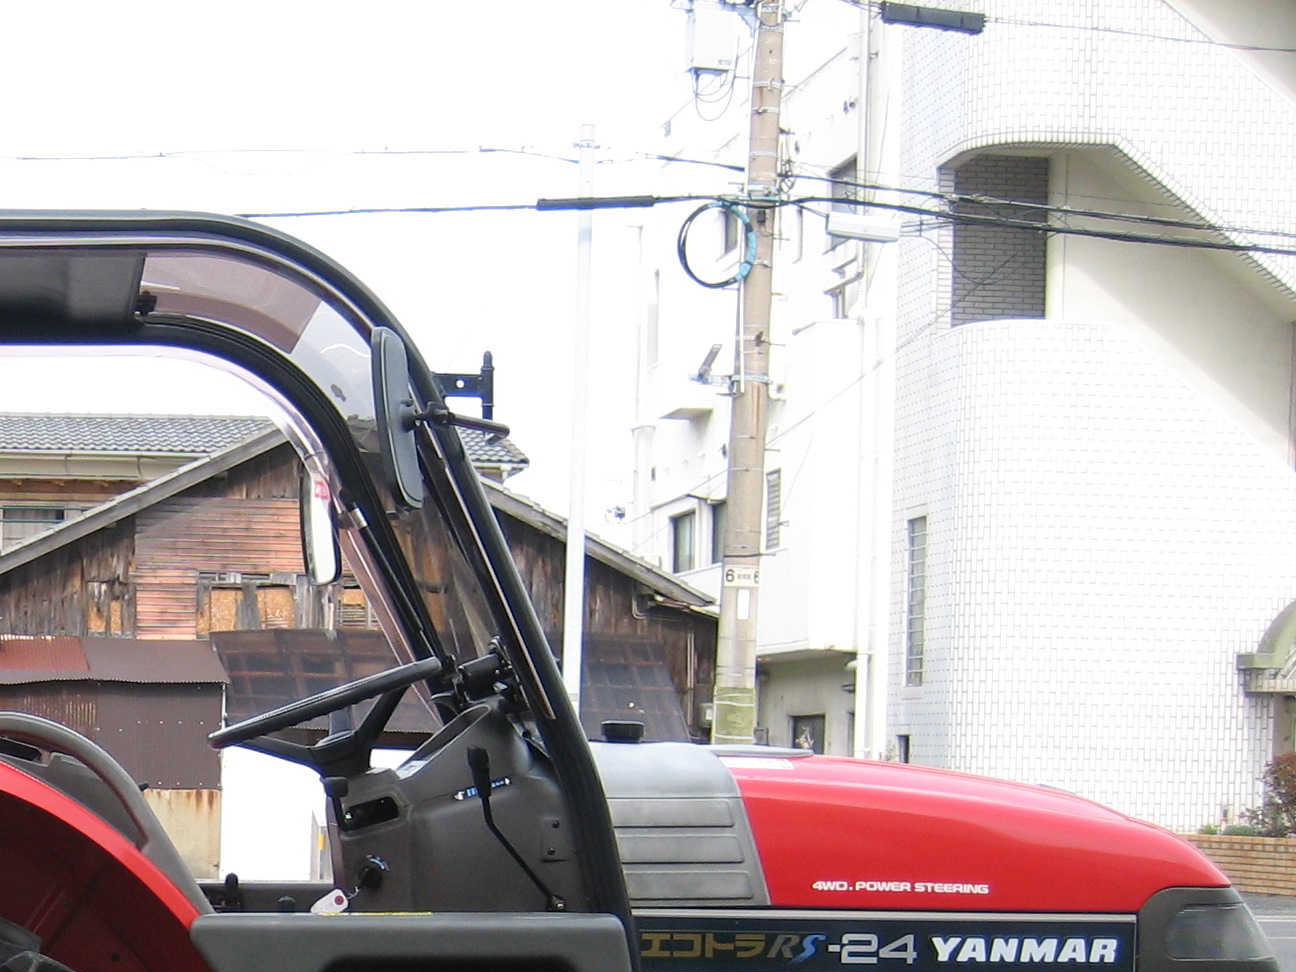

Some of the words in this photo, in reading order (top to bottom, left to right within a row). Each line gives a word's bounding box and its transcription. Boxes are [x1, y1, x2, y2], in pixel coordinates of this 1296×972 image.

[725, 569, 736, 583] 6
[855, 881, 912, 893] POWER
[914, 882, 989, 895] STEERING
[931, 936, 1118, 963] YANMAR
